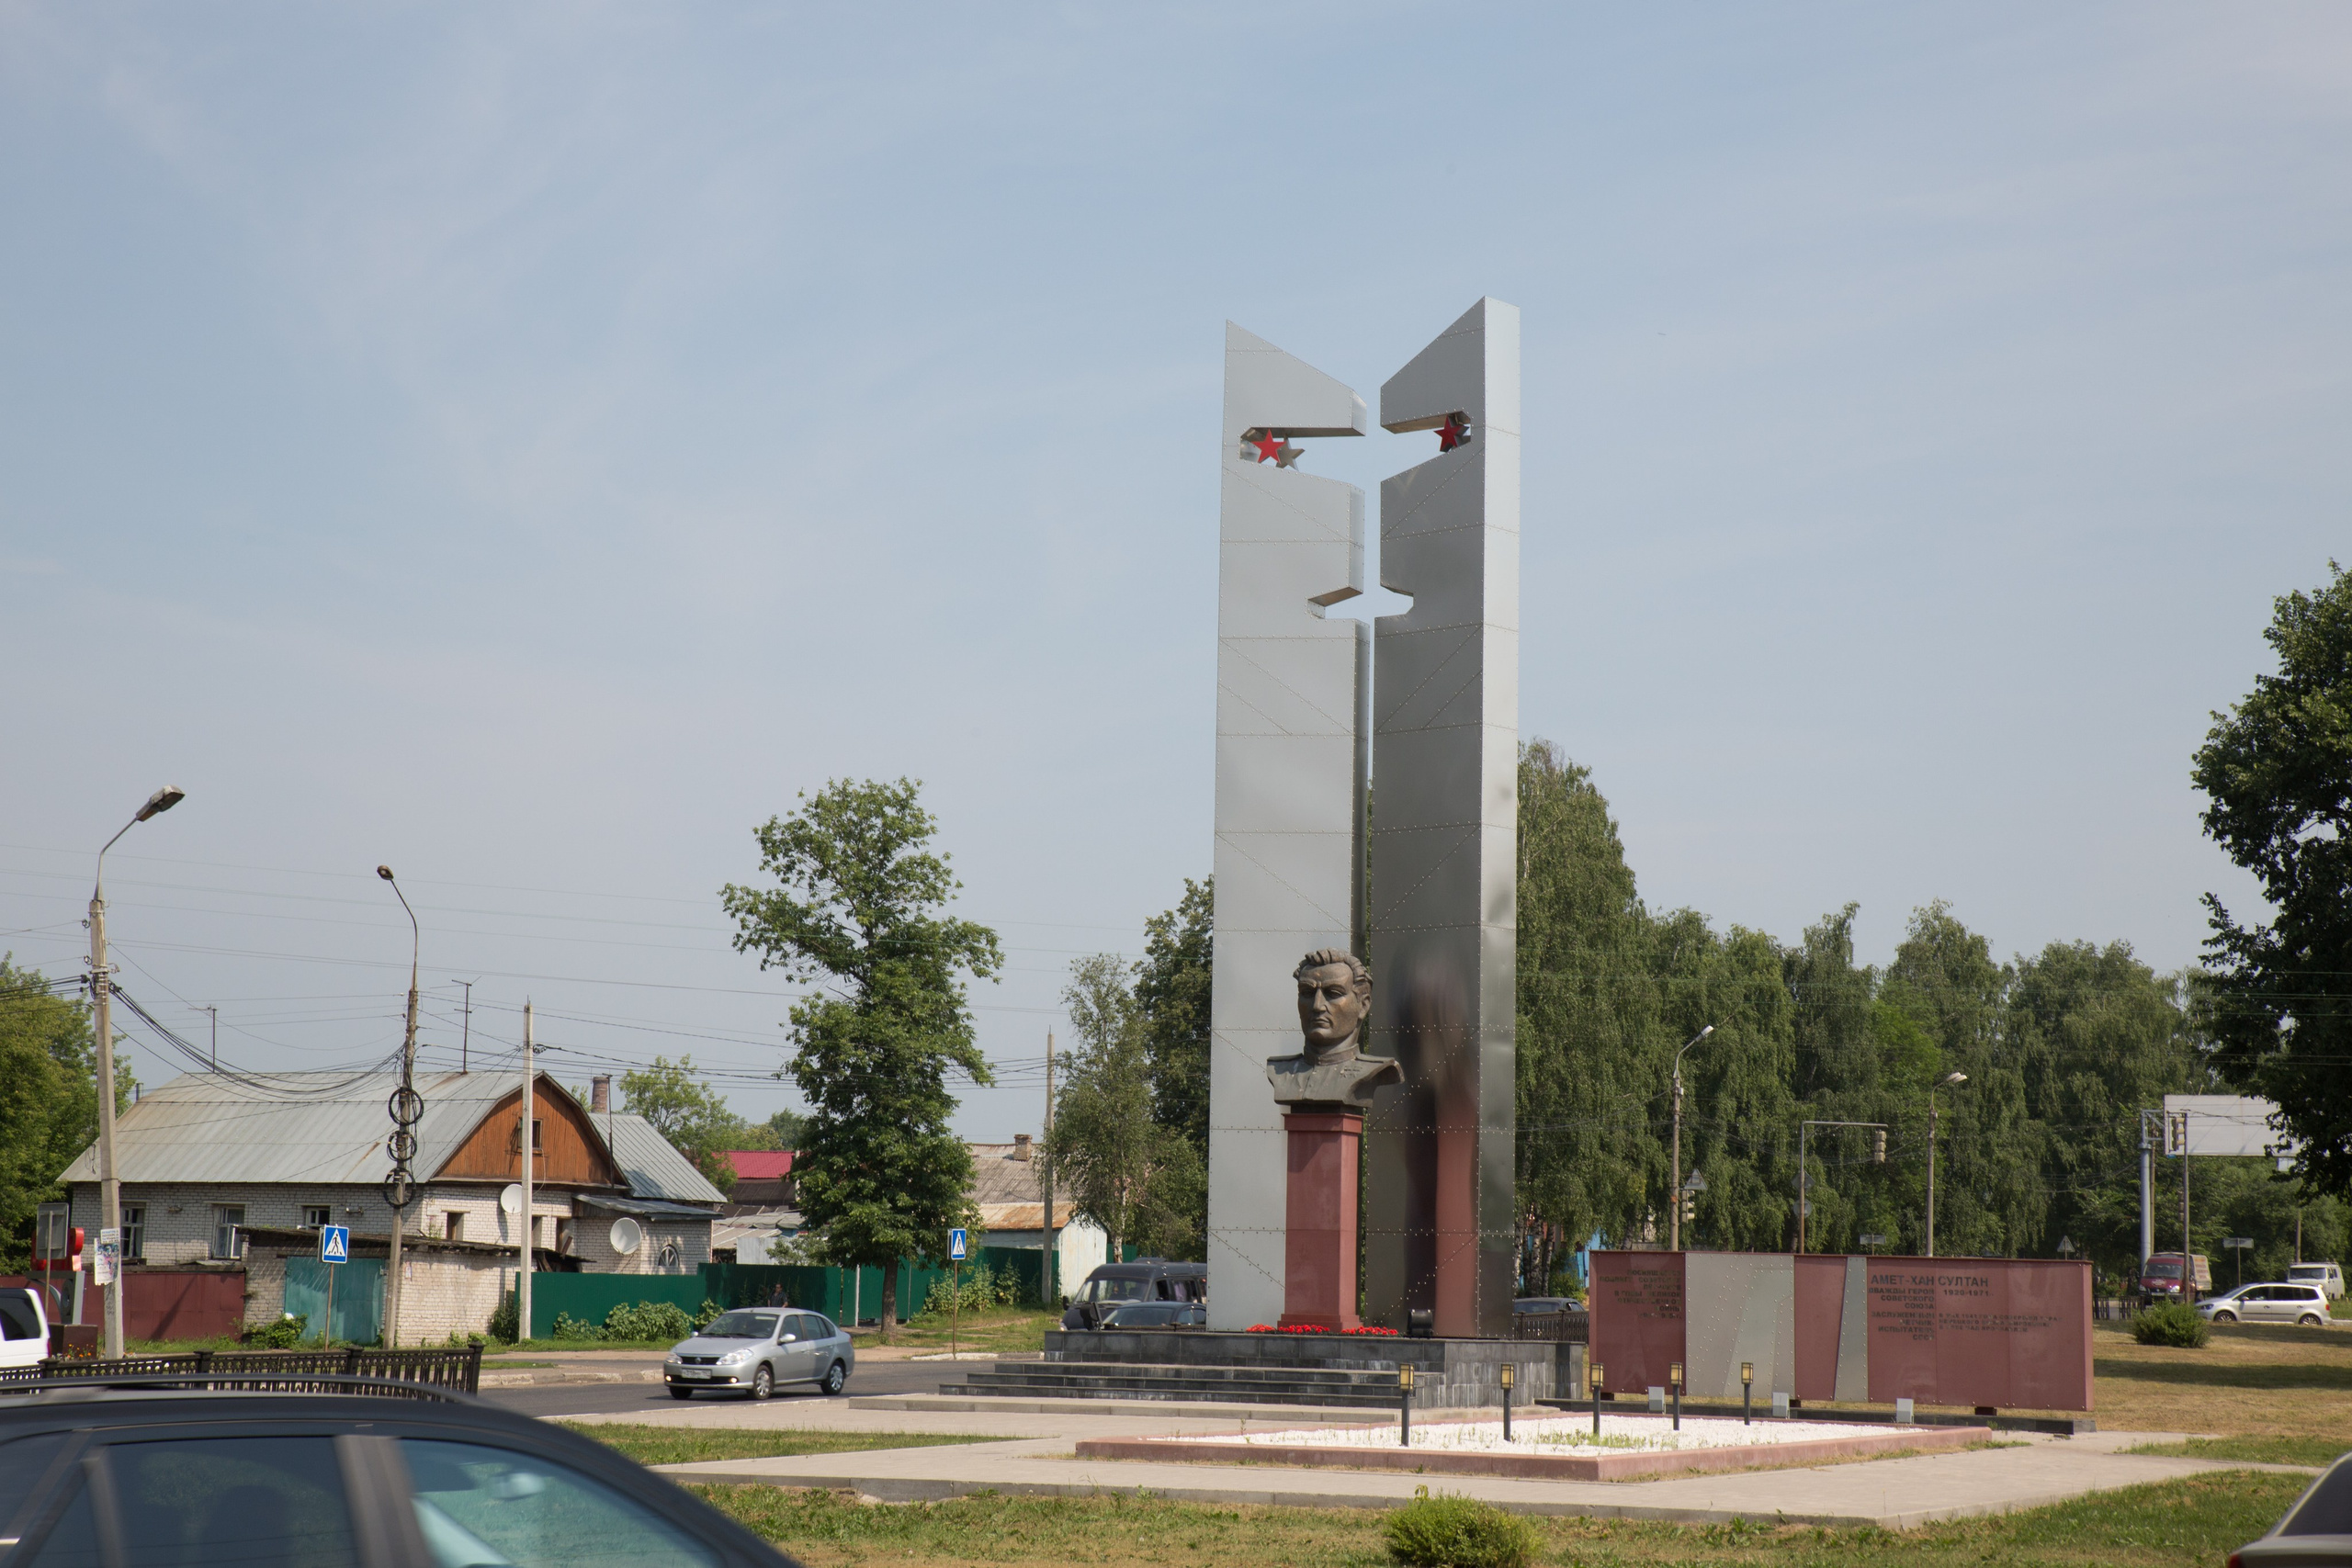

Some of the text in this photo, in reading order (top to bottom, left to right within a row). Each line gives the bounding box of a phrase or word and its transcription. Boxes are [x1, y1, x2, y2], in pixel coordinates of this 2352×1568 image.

[1871, 1274, 1988, 1287] АМЕТ-ХАН СУЛТАН
[1908, 1288, 1934, 1296] ГЕРОЙ
[1881, 1294, 1934, 1303] СОВЕТСКОГО
